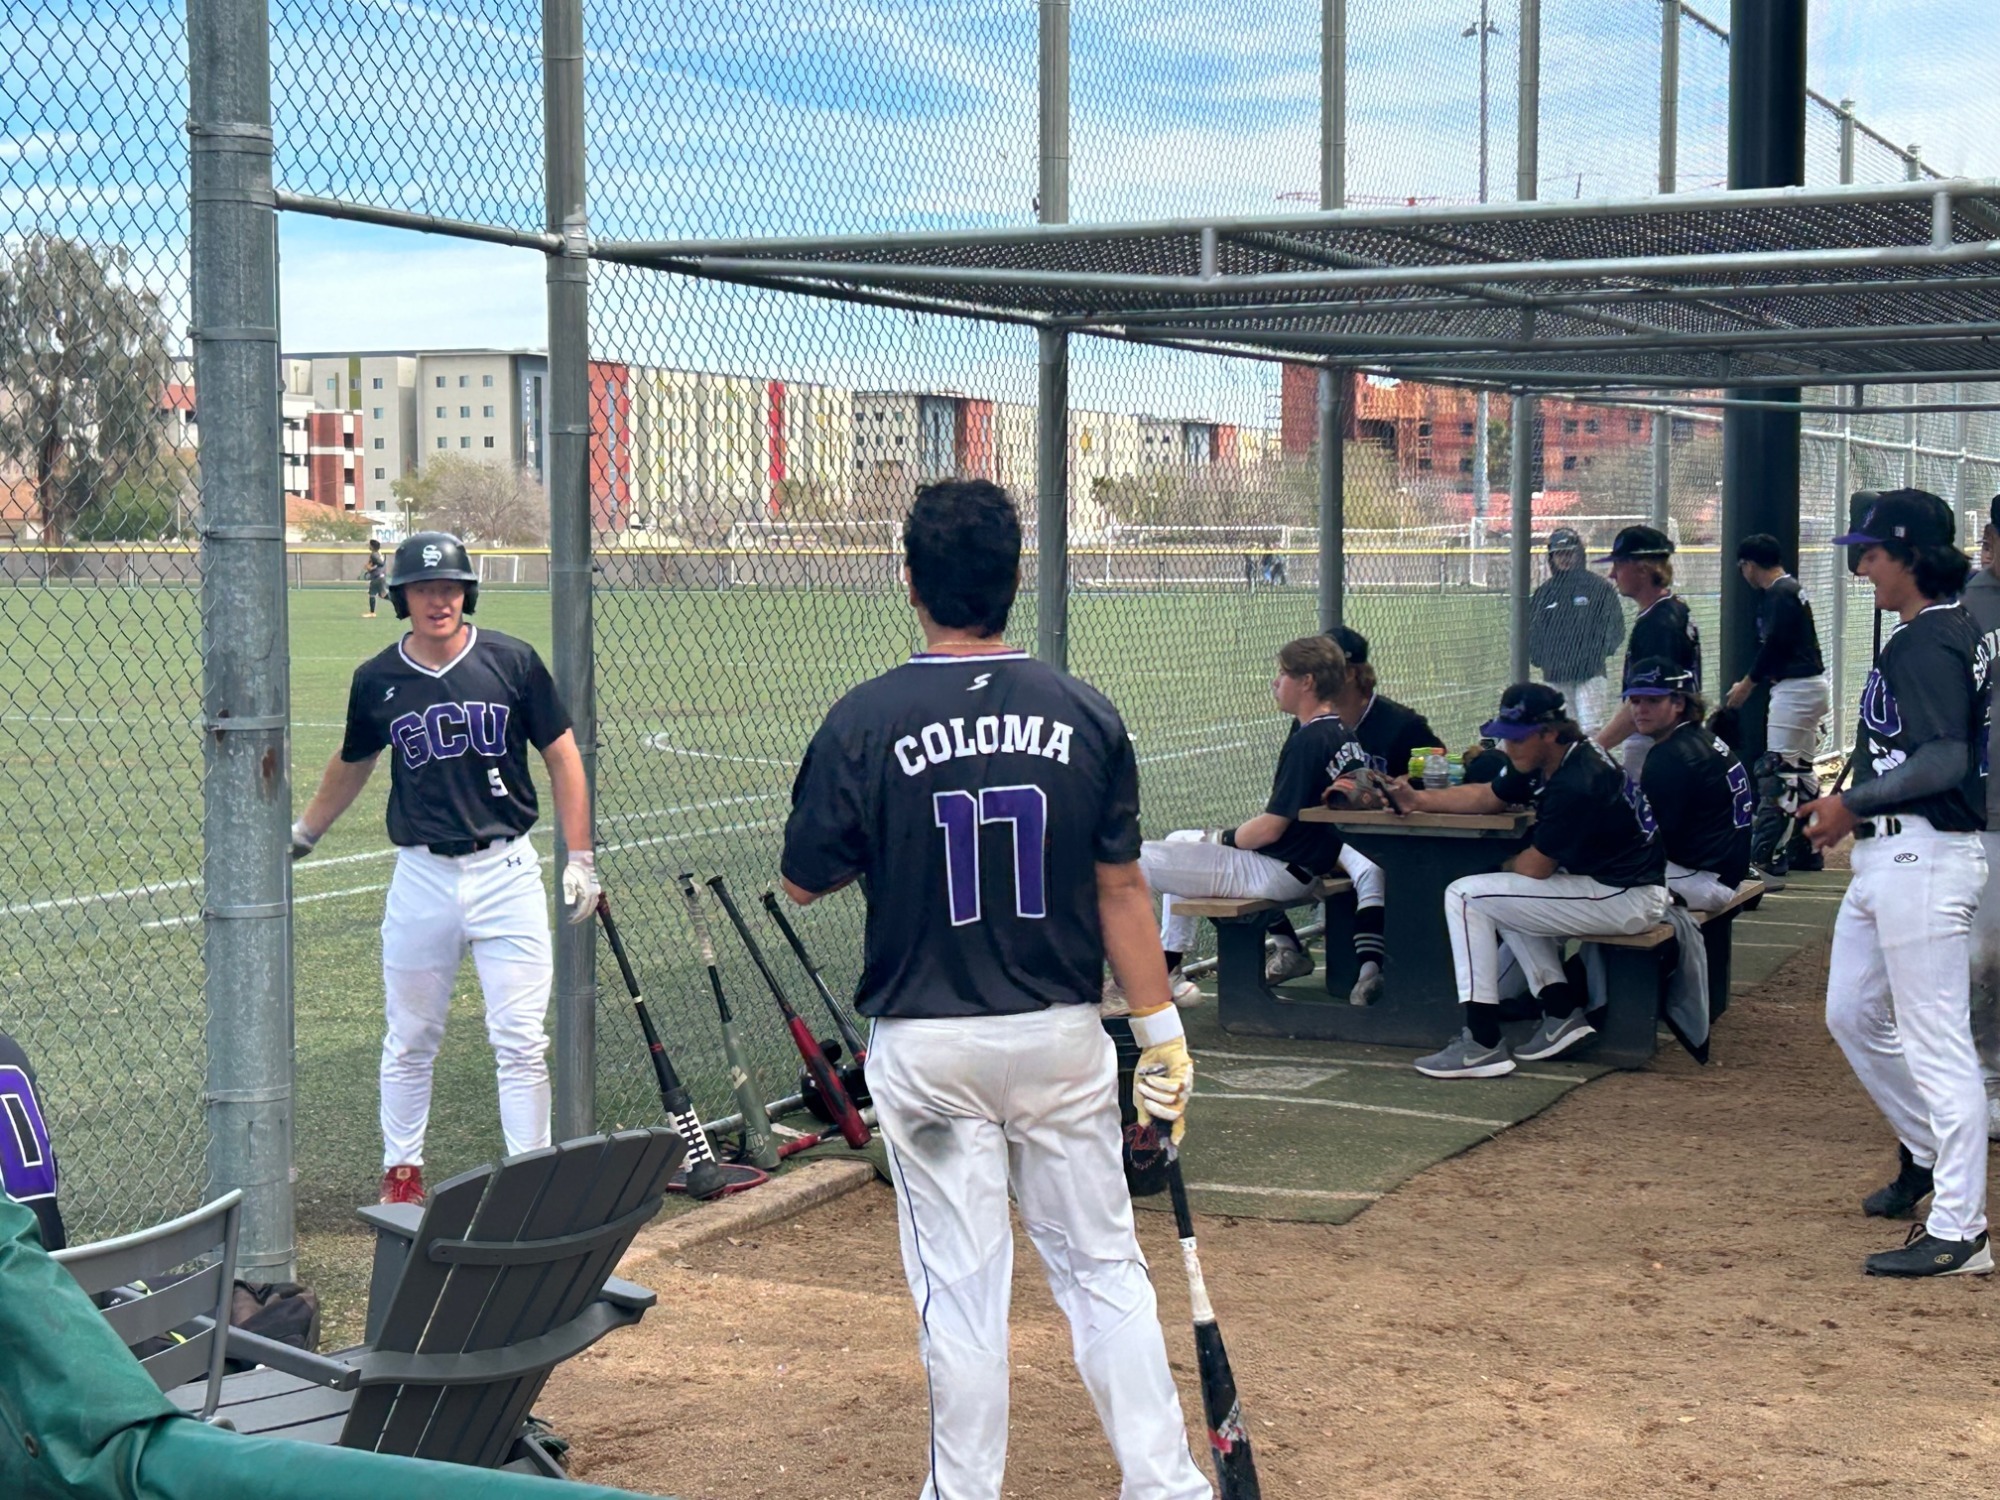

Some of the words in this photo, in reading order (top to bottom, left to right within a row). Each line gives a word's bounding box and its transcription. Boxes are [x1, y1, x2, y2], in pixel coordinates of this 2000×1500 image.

[390, 702, 510, 769] GCU
[894, 714, 1074, 777] COLOMA
[487, 767, 509, 797] 5
[932, 784, 1047, 926] 17
